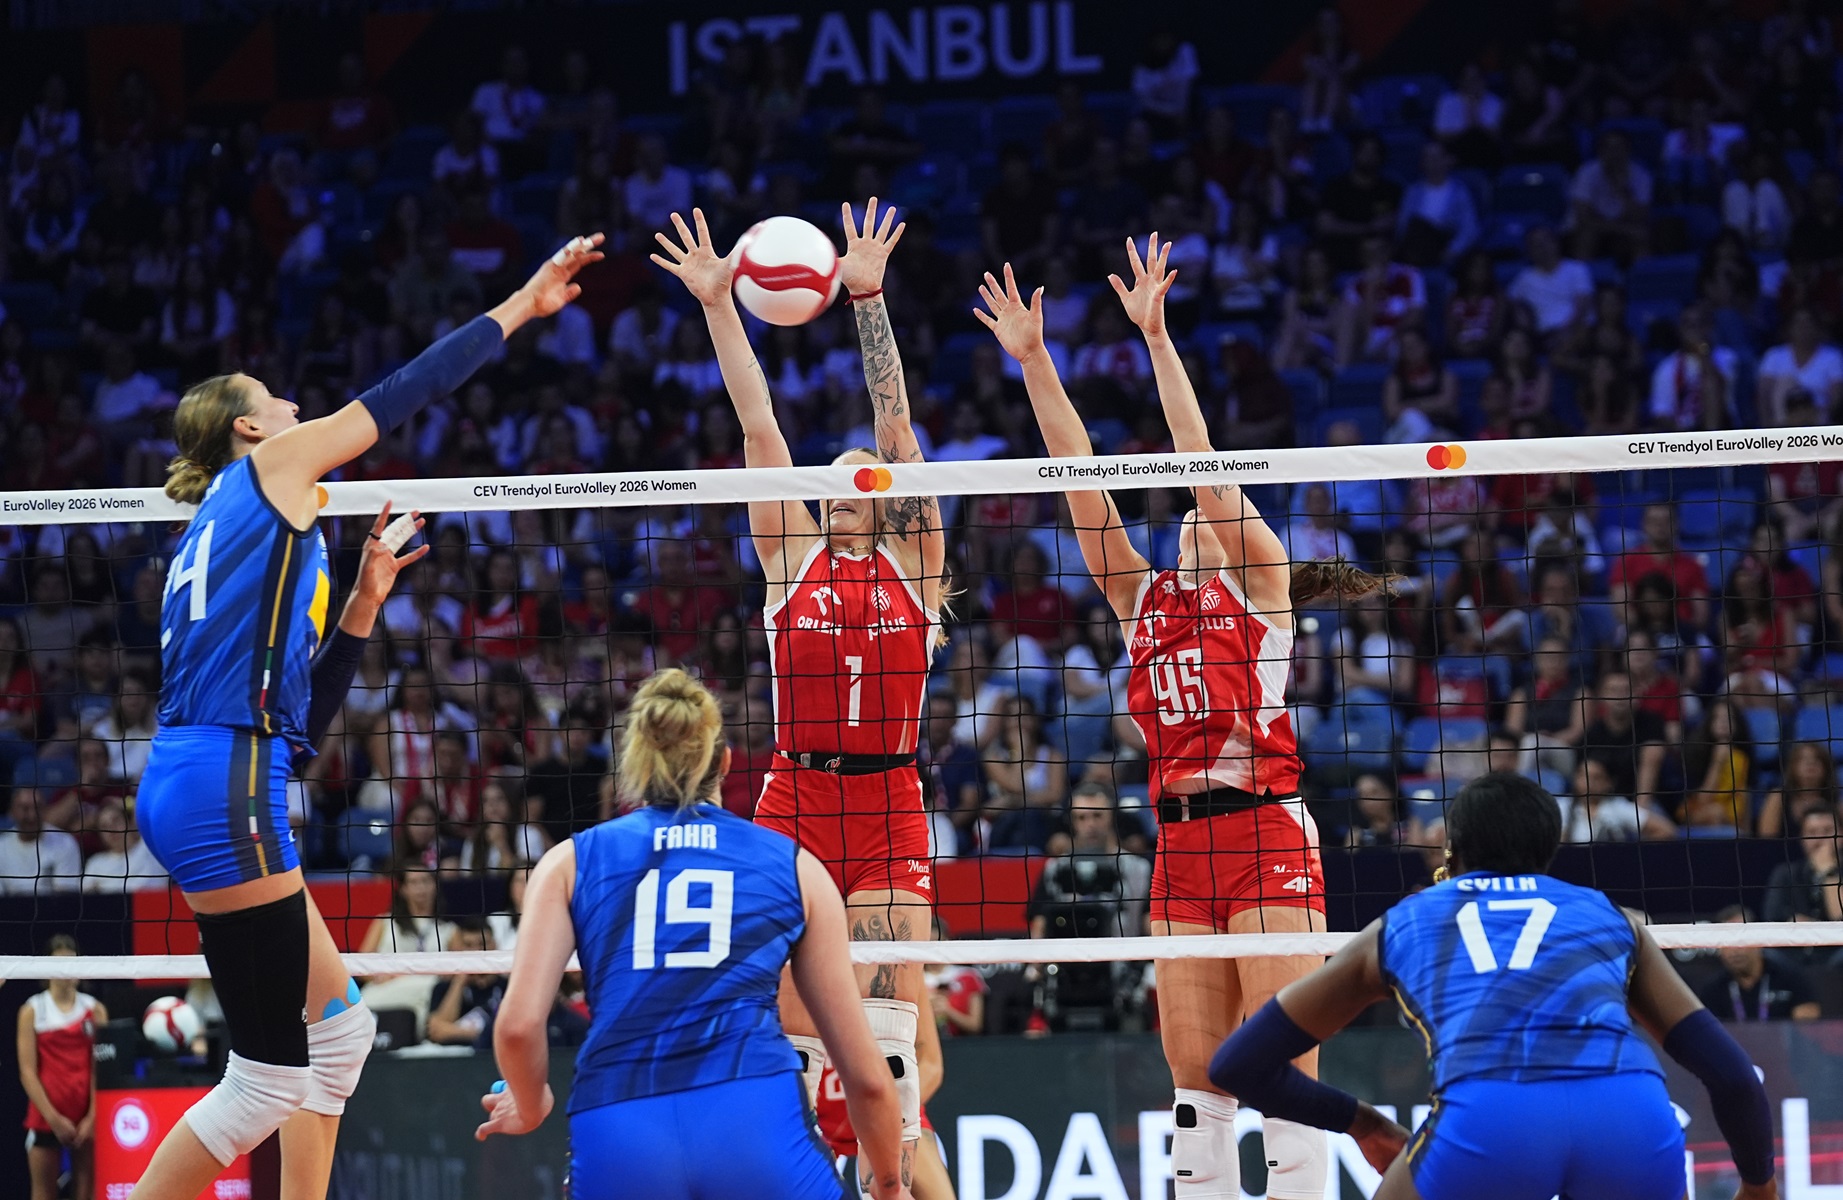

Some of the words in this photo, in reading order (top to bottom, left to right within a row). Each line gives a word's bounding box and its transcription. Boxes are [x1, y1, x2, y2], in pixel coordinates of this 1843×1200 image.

[1627, 442, 1655, 454] CEV
[1657, 439, 1712, 455] Trendyol
[1716, 437, 1784, 451] EuroVolley
[1786, 435, 1818, 447] 2026
[1037, 466, 1064, 478] CEV
[1066, 463, 1120, 479] Trendyol
[1122, 461, 1186, 476] EuroVolley
[1188, 460, 1219, 473] 2026
[1221, 459, 1269, 471] Women
[473, 485, 499, 497] CEV
[500, 483, 552, 498] Trendyol
[554, 481, 617, 496] EuroVolley
[619, 480, 649, 492] 2026
[650, 479, 697, 491] Women
[3, 499, 66, 513] EuroVolley
[67, 498, 97, 510] 2026
[99, 497, 145, 509] Women
[797, 615, 843, 636] ORLEN
[867, 616, 907, 641] plus
[845, 656, 863, 727] 1
[1149, 648, 1211, 726] 95
[653, 824, 718, 851] FAHR
[1282, 875, 1313, 893] 4F
[632, 868, 735, 970] 19
[1455, 897, 1558, 974] 17
